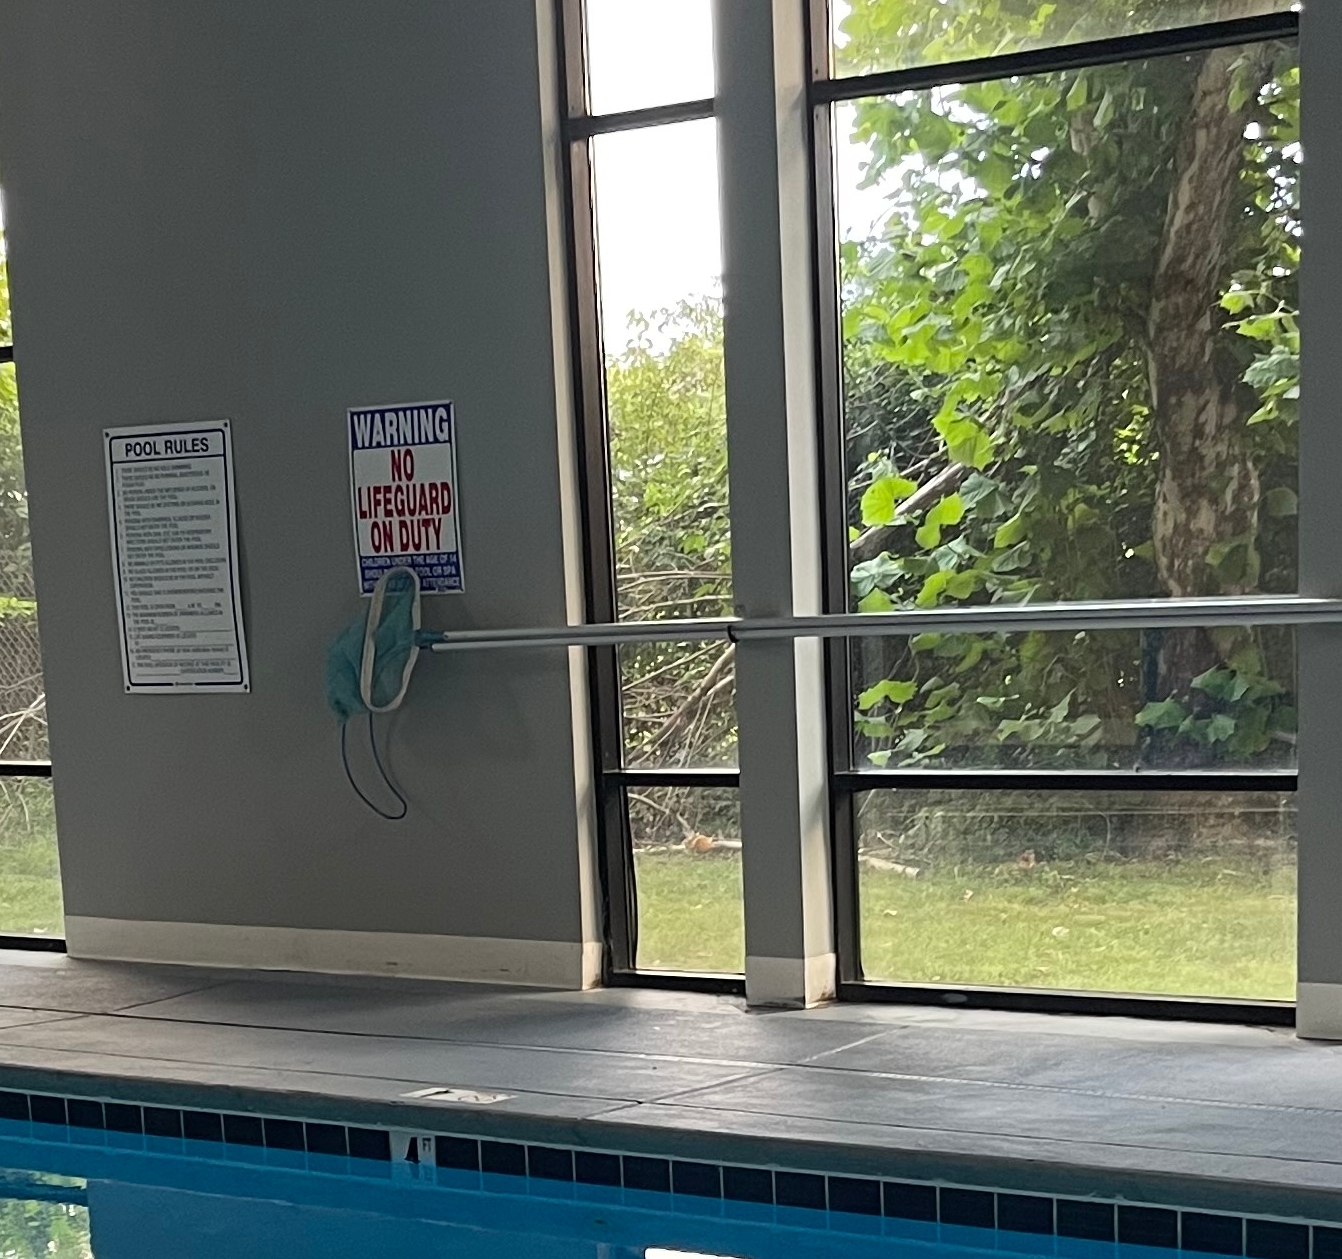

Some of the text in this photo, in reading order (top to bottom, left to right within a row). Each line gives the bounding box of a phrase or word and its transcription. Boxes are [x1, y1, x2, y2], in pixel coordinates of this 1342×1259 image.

[353, 407, 449, 448] WARNING
[125, 437, 209, 457] POOL RULES
[391, 449, 414, 481] NO
[358, 482, 452, 519] LIFEGUARD
[371, 518, 442, 553] ON DUTY
[362, 557, 391, 567] CHILDREN
[412, 555, 425, 564] THE
[426, 555, 439, 564] AGE
[440, 555, 450, 563] OF
[443, 566, 456, 575] SPA
